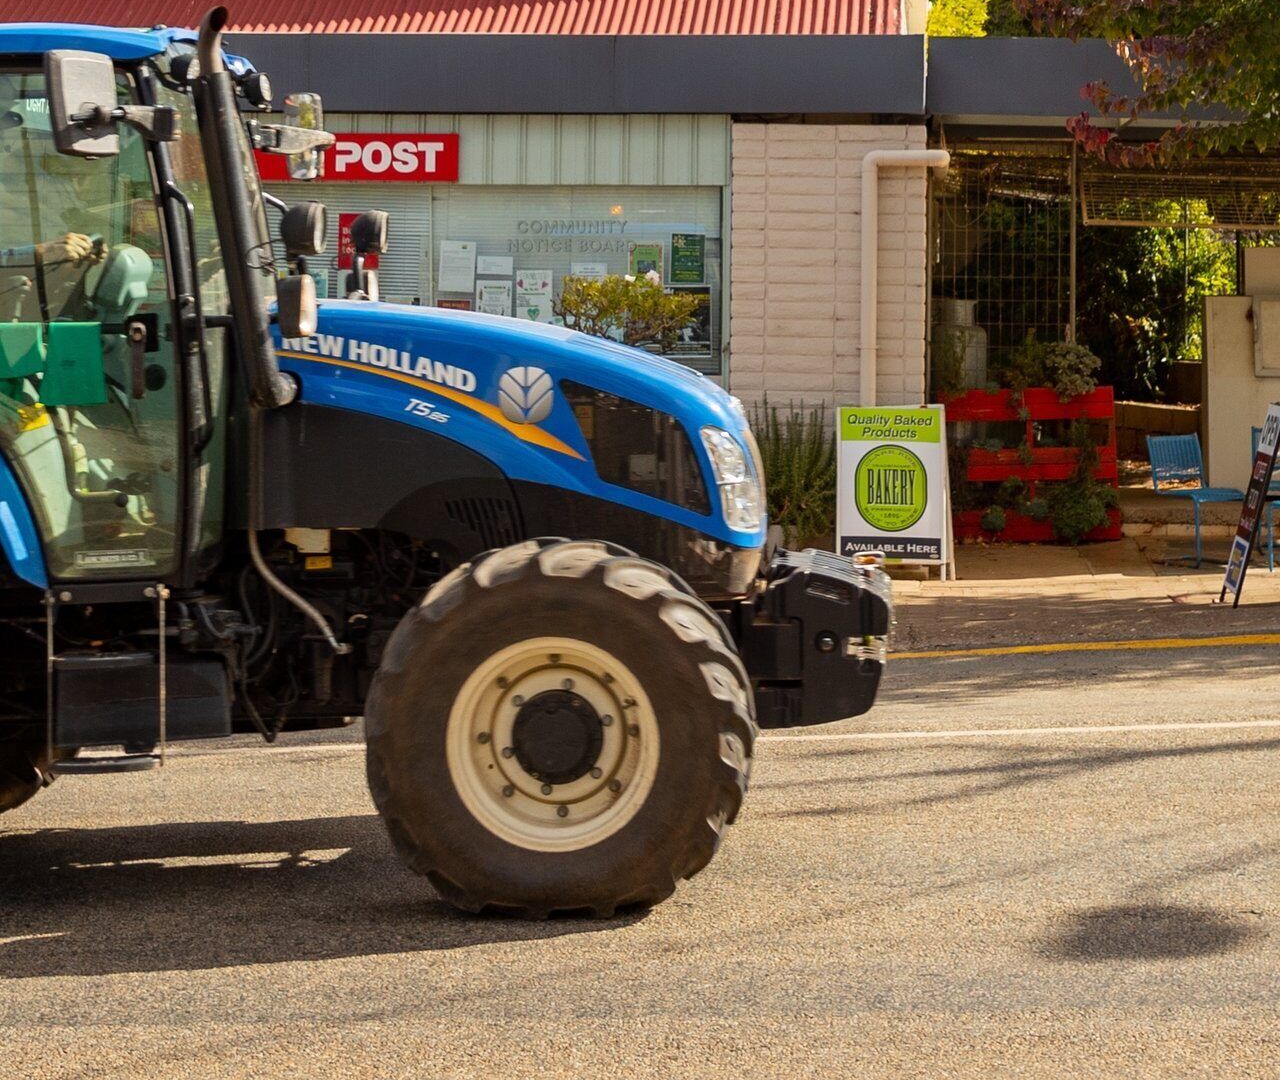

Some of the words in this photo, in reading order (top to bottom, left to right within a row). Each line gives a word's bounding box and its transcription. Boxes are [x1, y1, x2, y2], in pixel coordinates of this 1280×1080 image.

[335, 141, 445, 174] POST
[517, 220, 628, 235] COMMUNITY
[508, 238, 573, 254] NOTICE
[577, 238, 638, 254] BOARD
[282, 331, 345, 358] NEW
[348, 339, 477, 393] HOLLAND
[847, 413, 891, 428] Quality
[894, 414, 934, 427] Baked
[862, 426, 918, 439] Products
[867, 468, 916, 506] BAKERY
[845, 542, 904, 553] AVAILABLE
[906, 543, 938, 554] HERE
